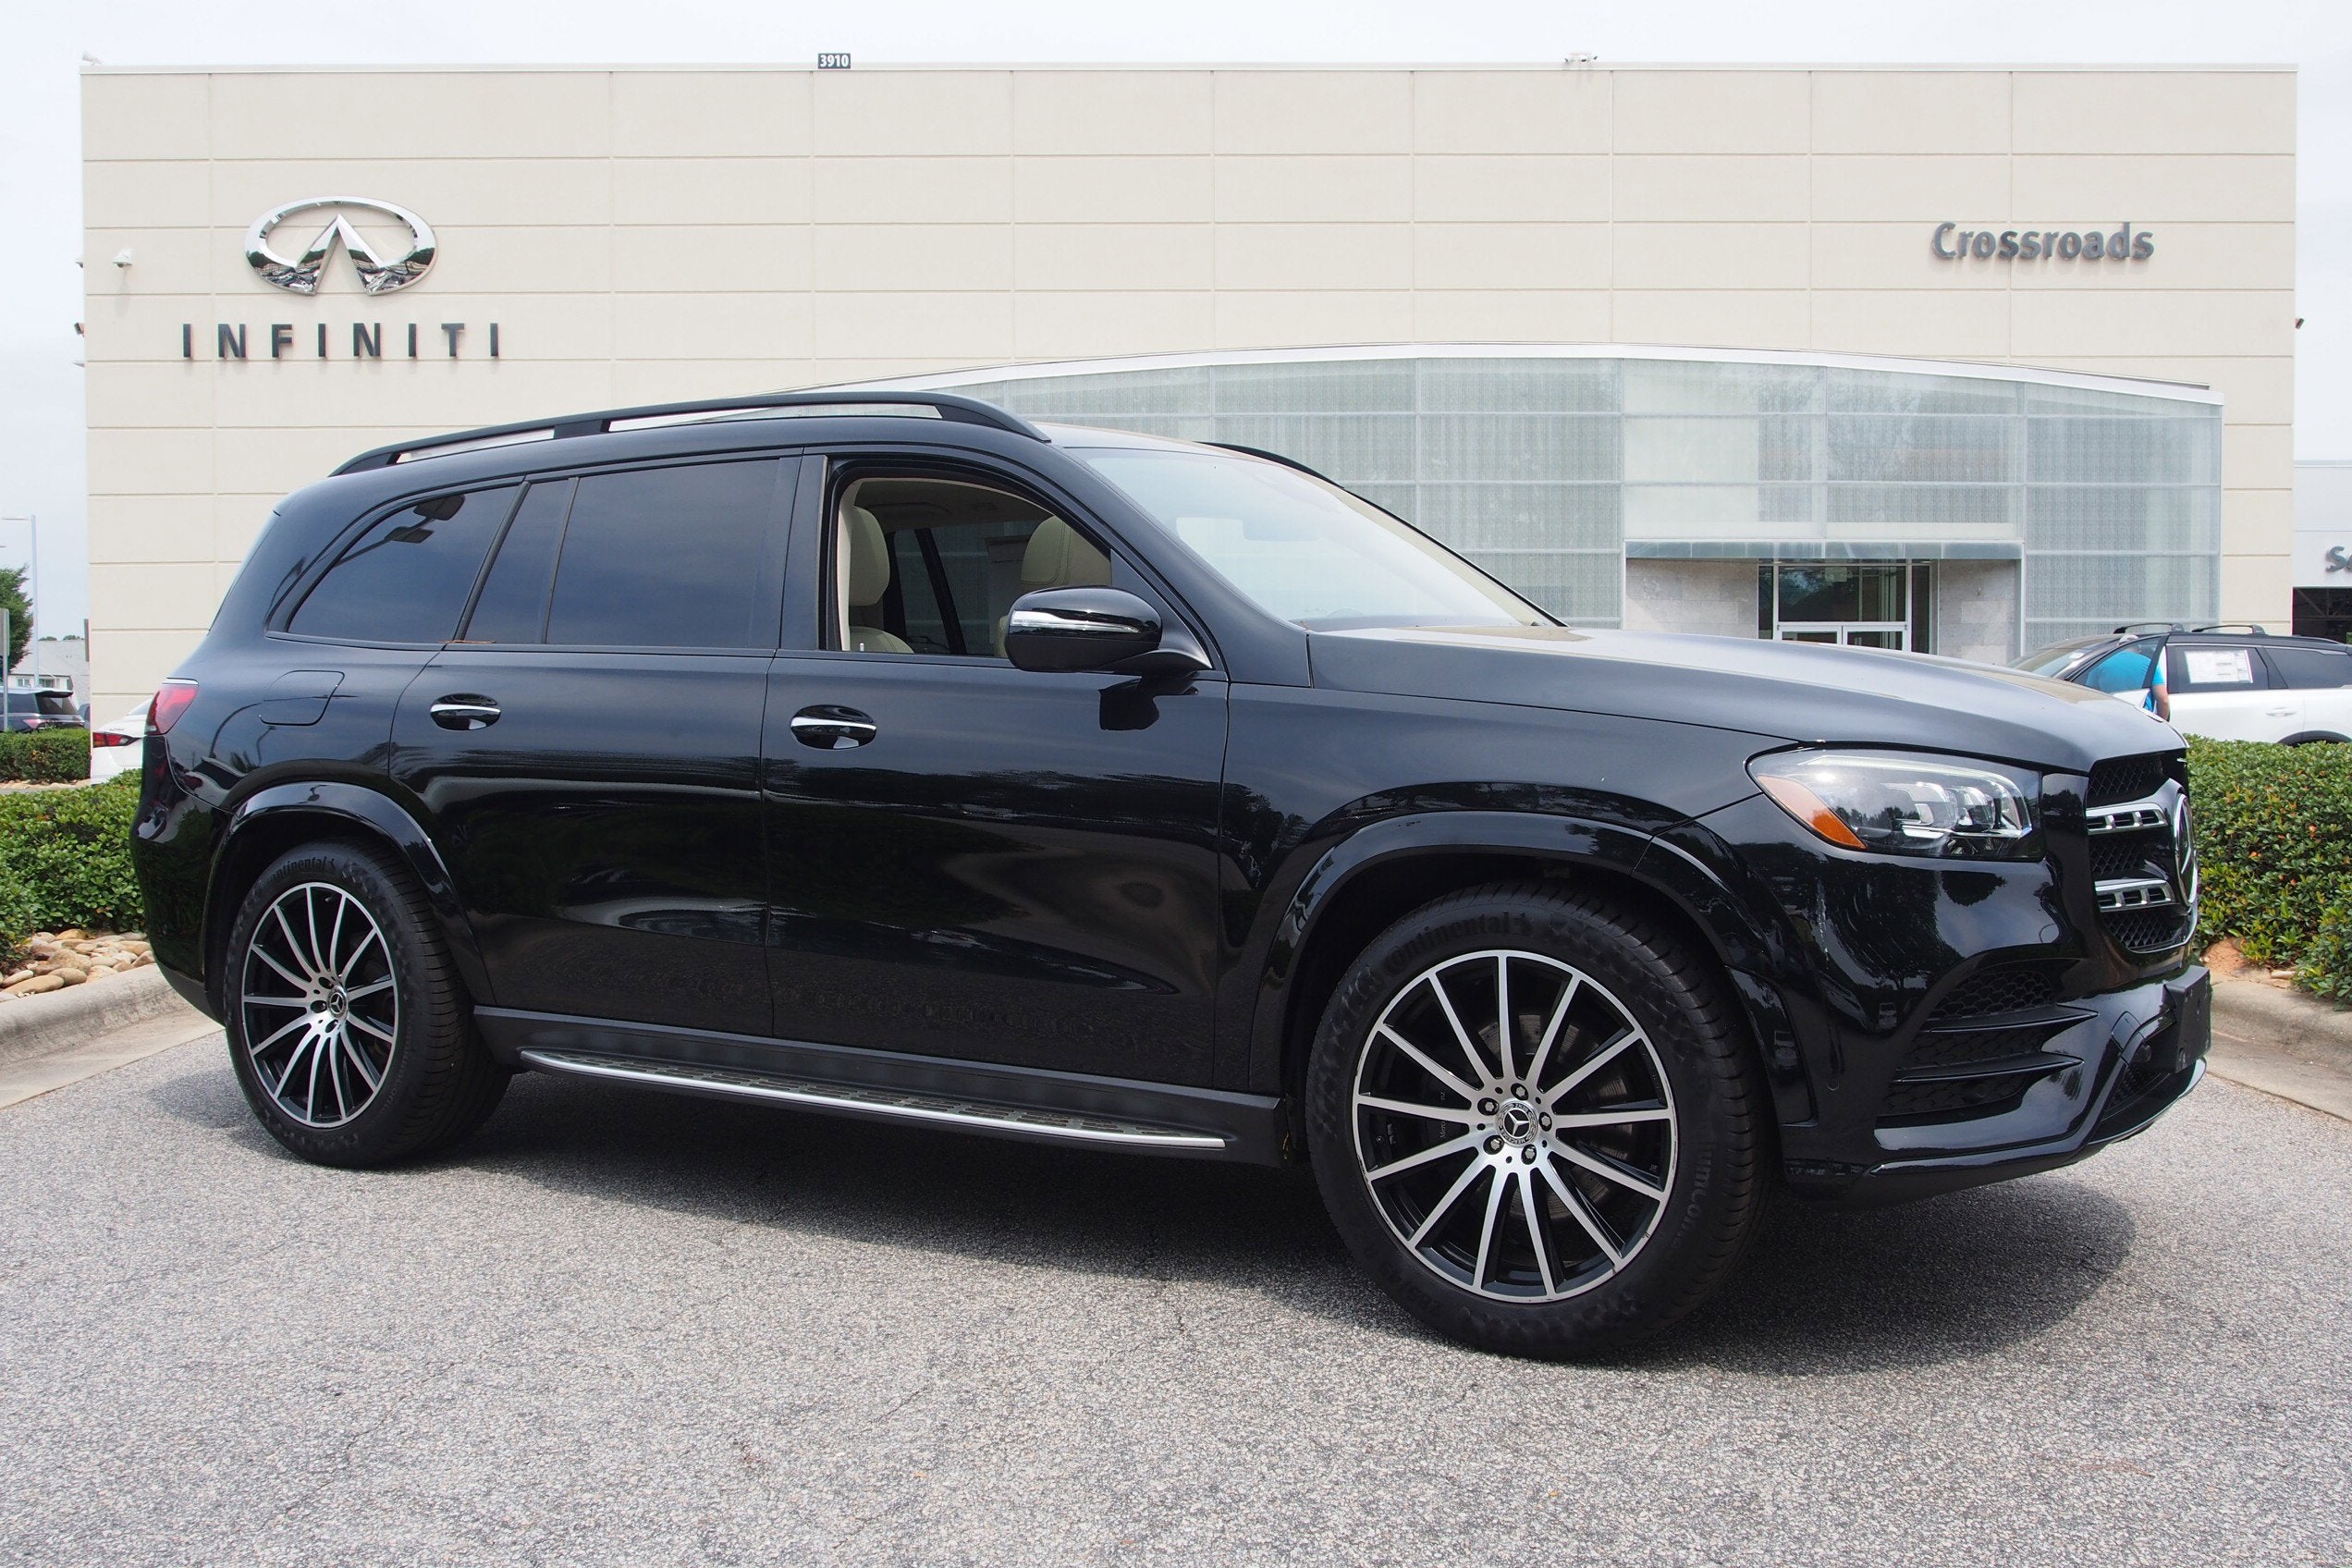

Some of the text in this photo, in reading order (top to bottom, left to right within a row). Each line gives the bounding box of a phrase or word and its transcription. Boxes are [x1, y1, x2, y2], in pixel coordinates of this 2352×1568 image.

[819, 54, 850, 67] 3910
[1931, 221, 2155, 260] Crossroads
[182, 323, 500, 359] INFINITI
[1384, 911, 1512, 975] Continental
